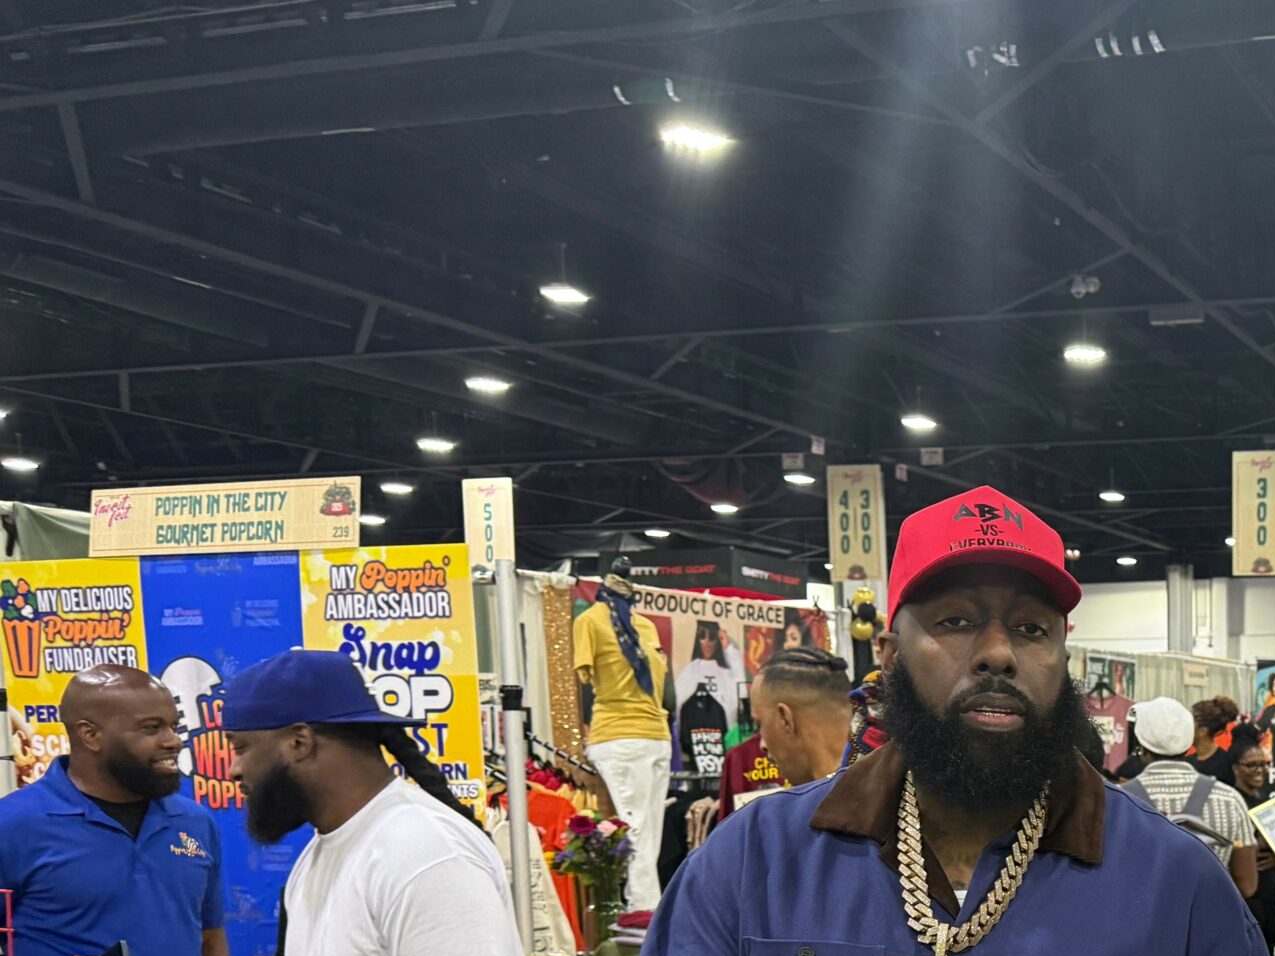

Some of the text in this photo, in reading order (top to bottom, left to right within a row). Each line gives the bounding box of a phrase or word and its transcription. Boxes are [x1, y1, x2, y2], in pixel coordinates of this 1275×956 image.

[155, 490, 288, 517] POPPIN IN THE CITY
[1257, 477, 1268, 546] 300
[156, 519, 285, 547] GOURMET POPCORN
[332, 526, 349, 539] 239
[330, 565, 358, 591] MY
[36, 586, 133, 614] MY DELICIOUS
[325, 591, 452, 620] AMBASSADOR
[633, 591, 784, 625] PRODUCT OF GRACE
[44, 646, 138, 673] FUNDRAISER
